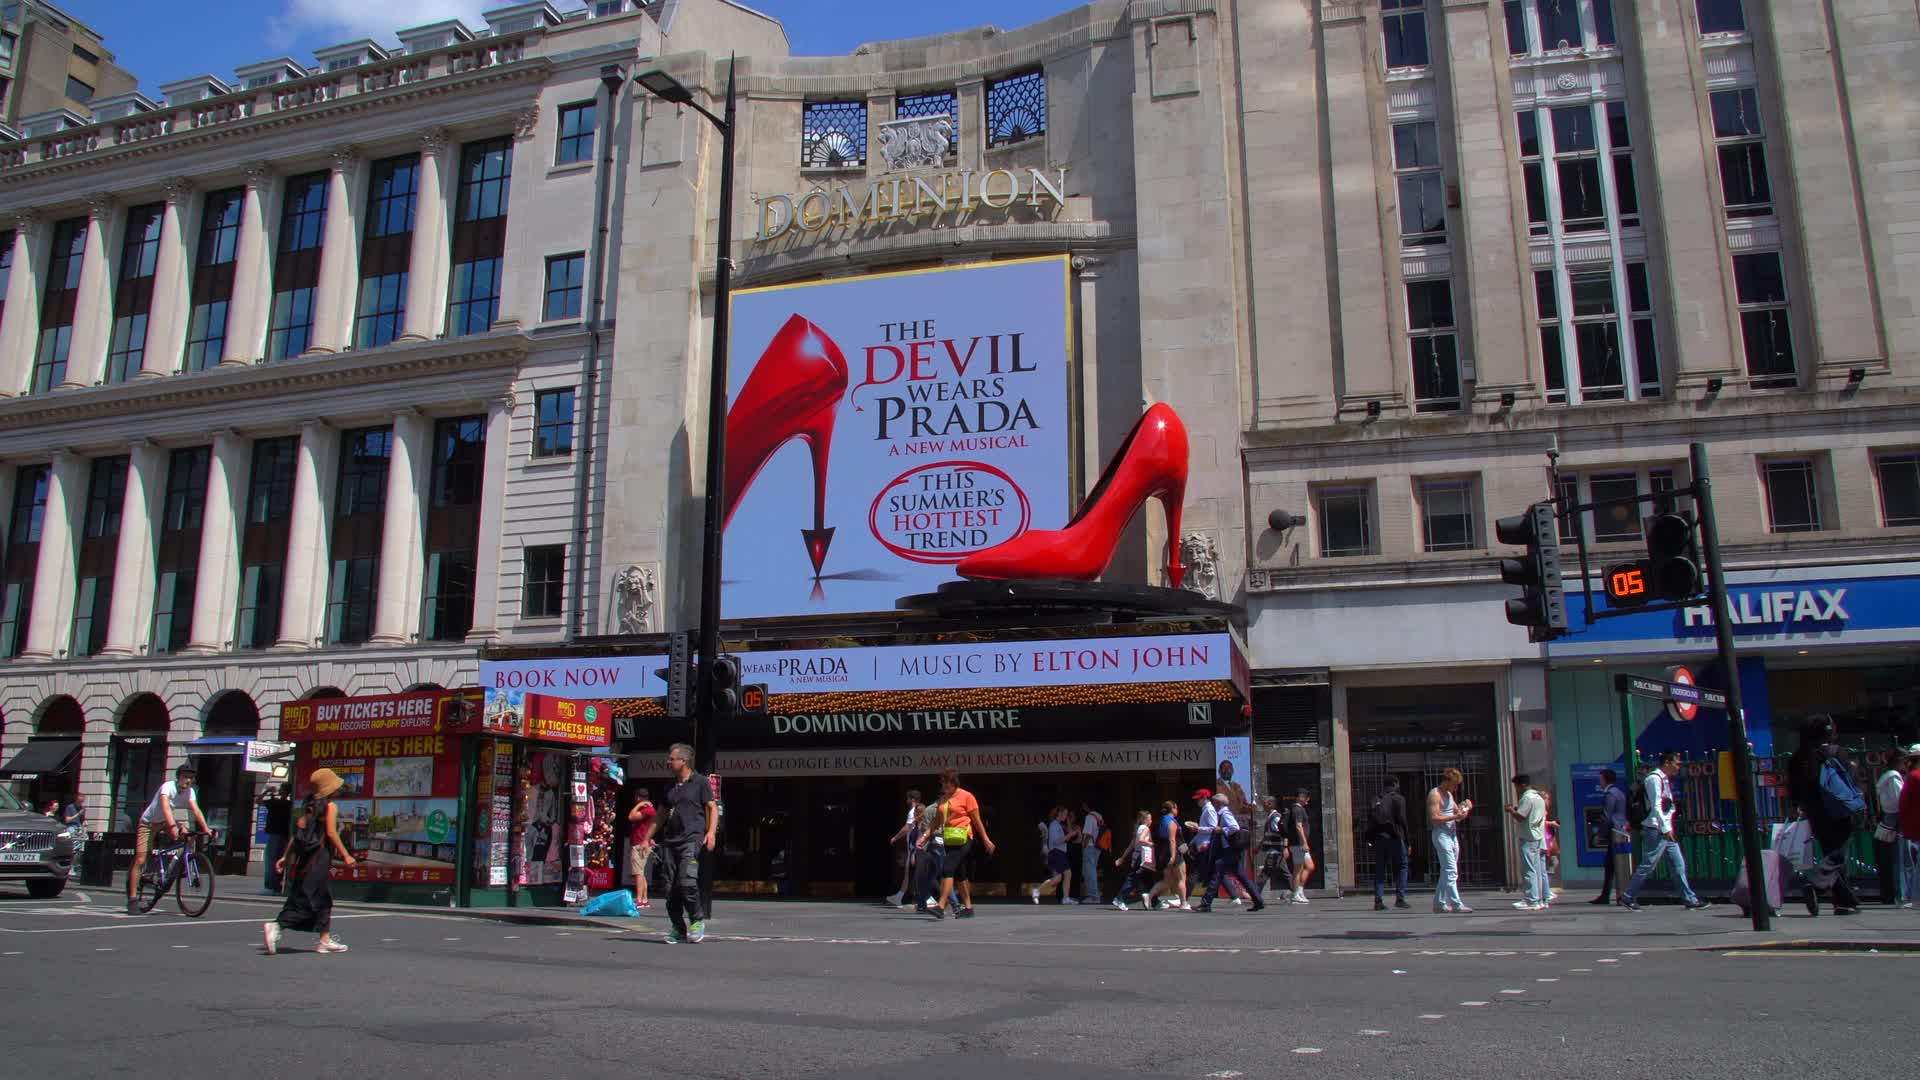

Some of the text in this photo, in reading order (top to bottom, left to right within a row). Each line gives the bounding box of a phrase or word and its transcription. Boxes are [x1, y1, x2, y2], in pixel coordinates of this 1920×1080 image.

[756, 167, 1070, 242] DOMINION
[880, 319, 936, 342] THE
[861, 332, 1038, 385] DEVIL
[906, 377, 1005, 403] WEARS
[874, 397, 1040, 441] PRADA
[888, 434, 1029, 457] A NEW MUSICAL
[919, 471, 974, 491] THIS
[889, 488, 1006, 513] SUMMER'S
[893, 508, 1003, 532] HOTTEST
[905, 530, 988, 551] TREND
[1612, 570, 1645, 597] 05
[743, 656, 848, 677] WEARS PRADA
[900, 644, 1210, 676] MUSIC BY ELTON JOHN
[495, 666, 621, 689] BOOK NOW
[796, 676, 814, 684] NEW
[745, 691, 762, 708] 05
[1670, 686, 1698, 699] UNDERGROUND
[317, 698, 433, 721] BUY TICKETS HERE
[772, 708, 1022, 734] DOMINION THEATRE
[529, 717, 606, 737] BUY TICKETS HERE
[312, 735, 445, 759] BUY TICKETS HERE
[714, 758, 761, 770] LLIAMS
[767, 757, 831, 769] GEORGIE
[834, 755, 913, 770] BUCKLAND
[919, 752, 952, 769] AMY
[1085, 751, 1097, 764] &
[1101, 749, 1145, 764] MATT
[1148, 748, 1202, 762] HENRY
